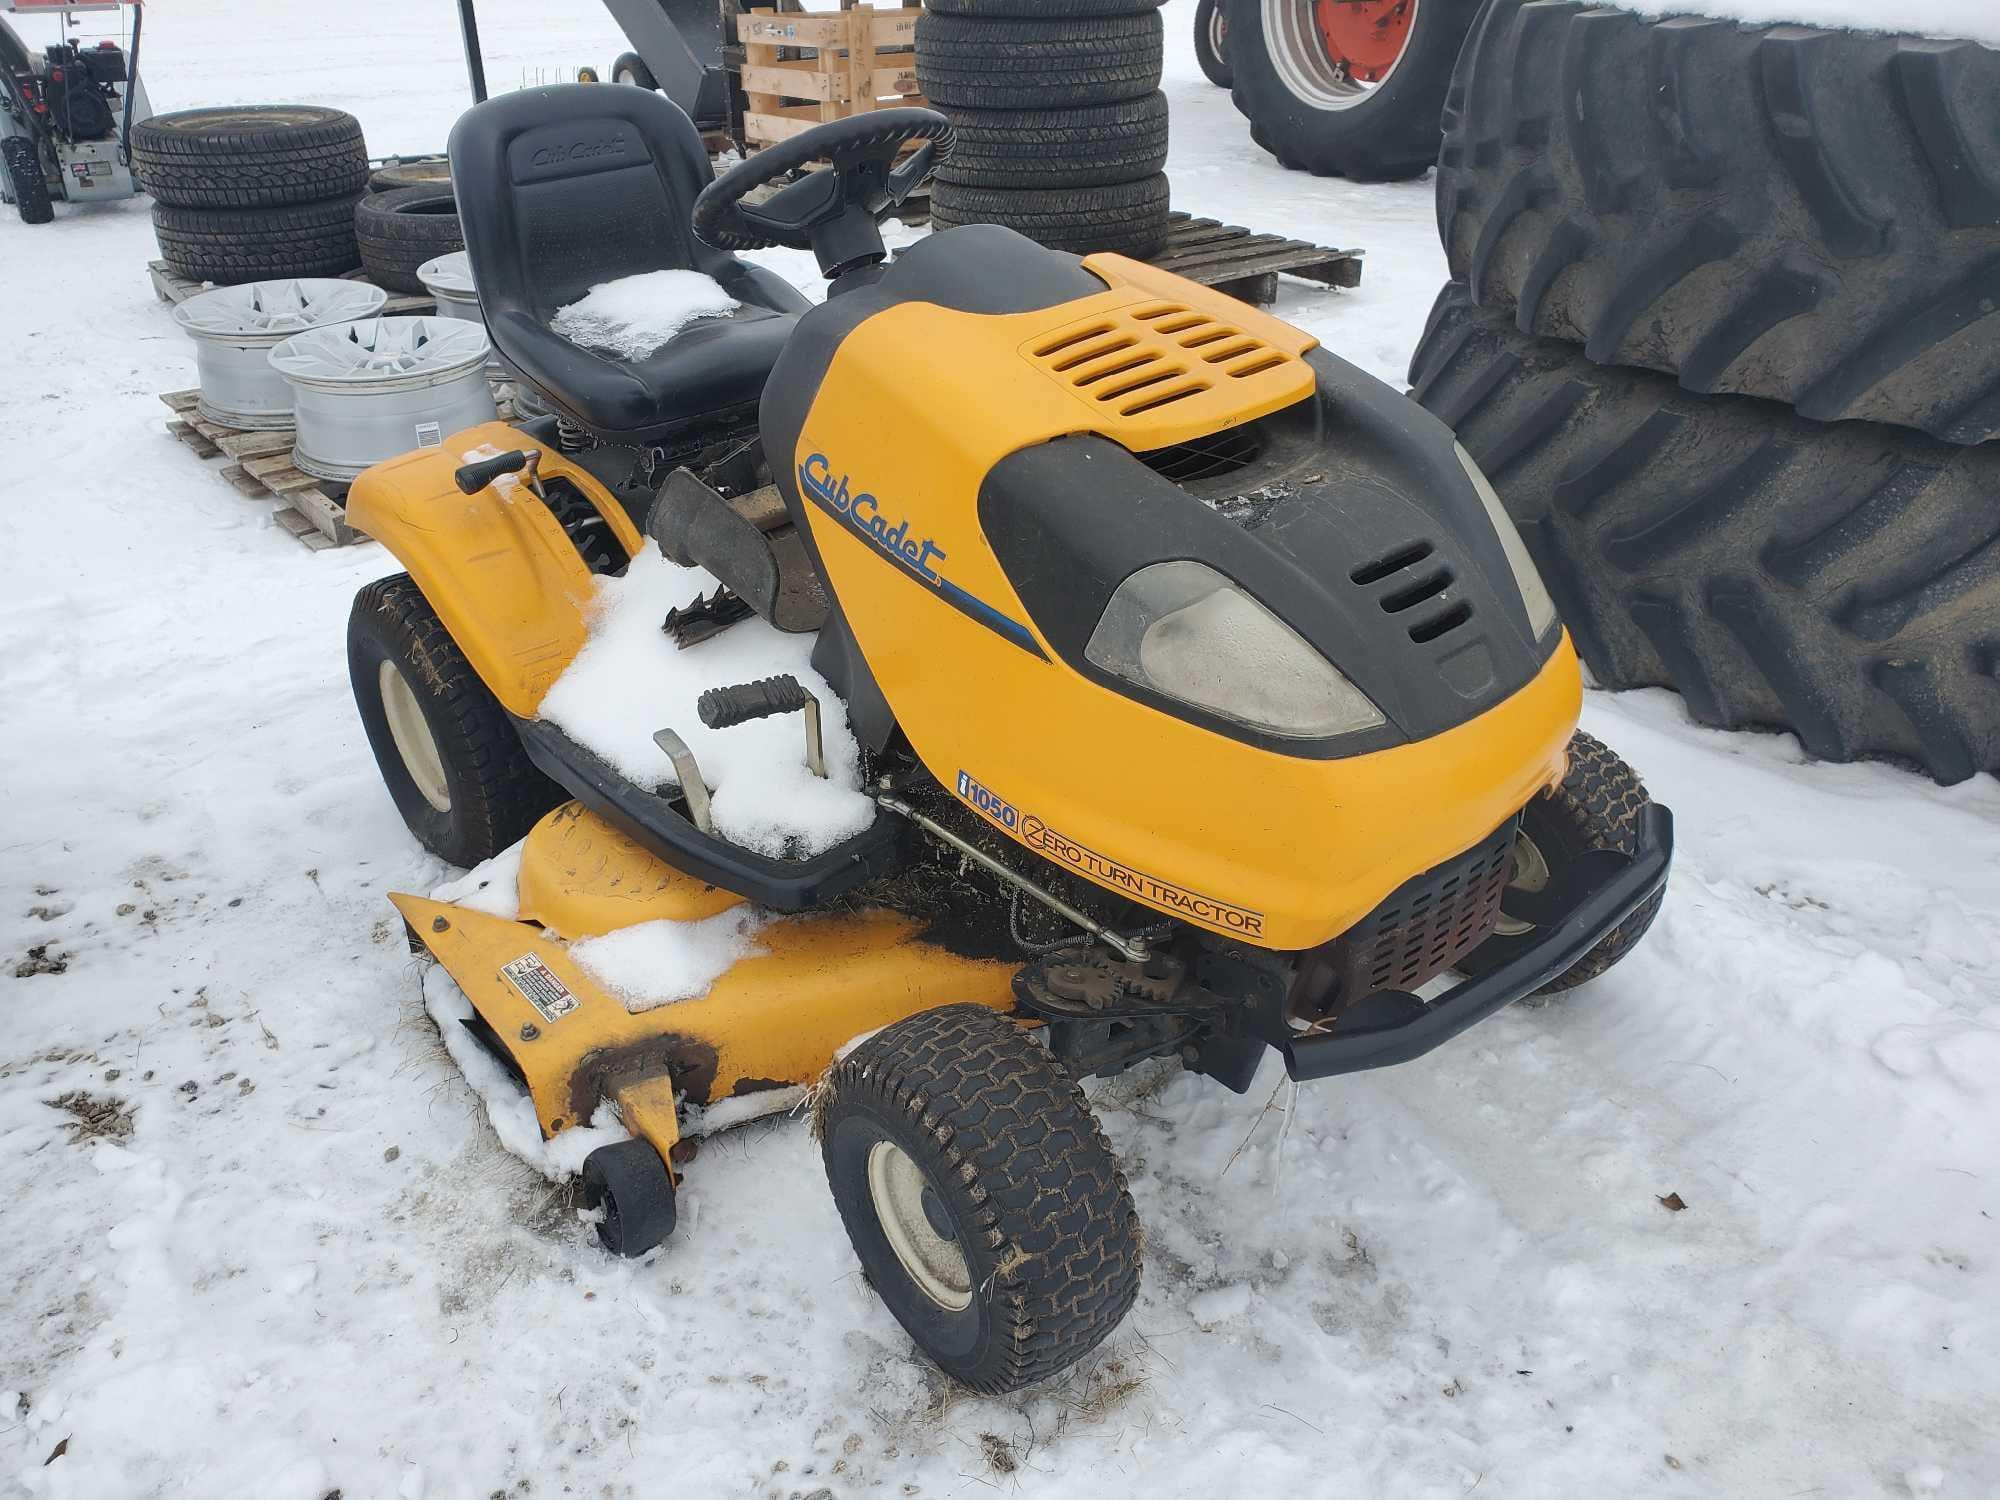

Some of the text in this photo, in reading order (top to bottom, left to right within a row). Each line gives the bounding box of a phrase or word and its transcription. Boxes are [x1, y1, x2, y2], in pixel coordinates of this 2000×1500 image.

[804, 453, 945, 582] Cub Cadet
[1084, 853, 1143, 893] TURN
[1147, 881, 1262, 933] TRACTOR
